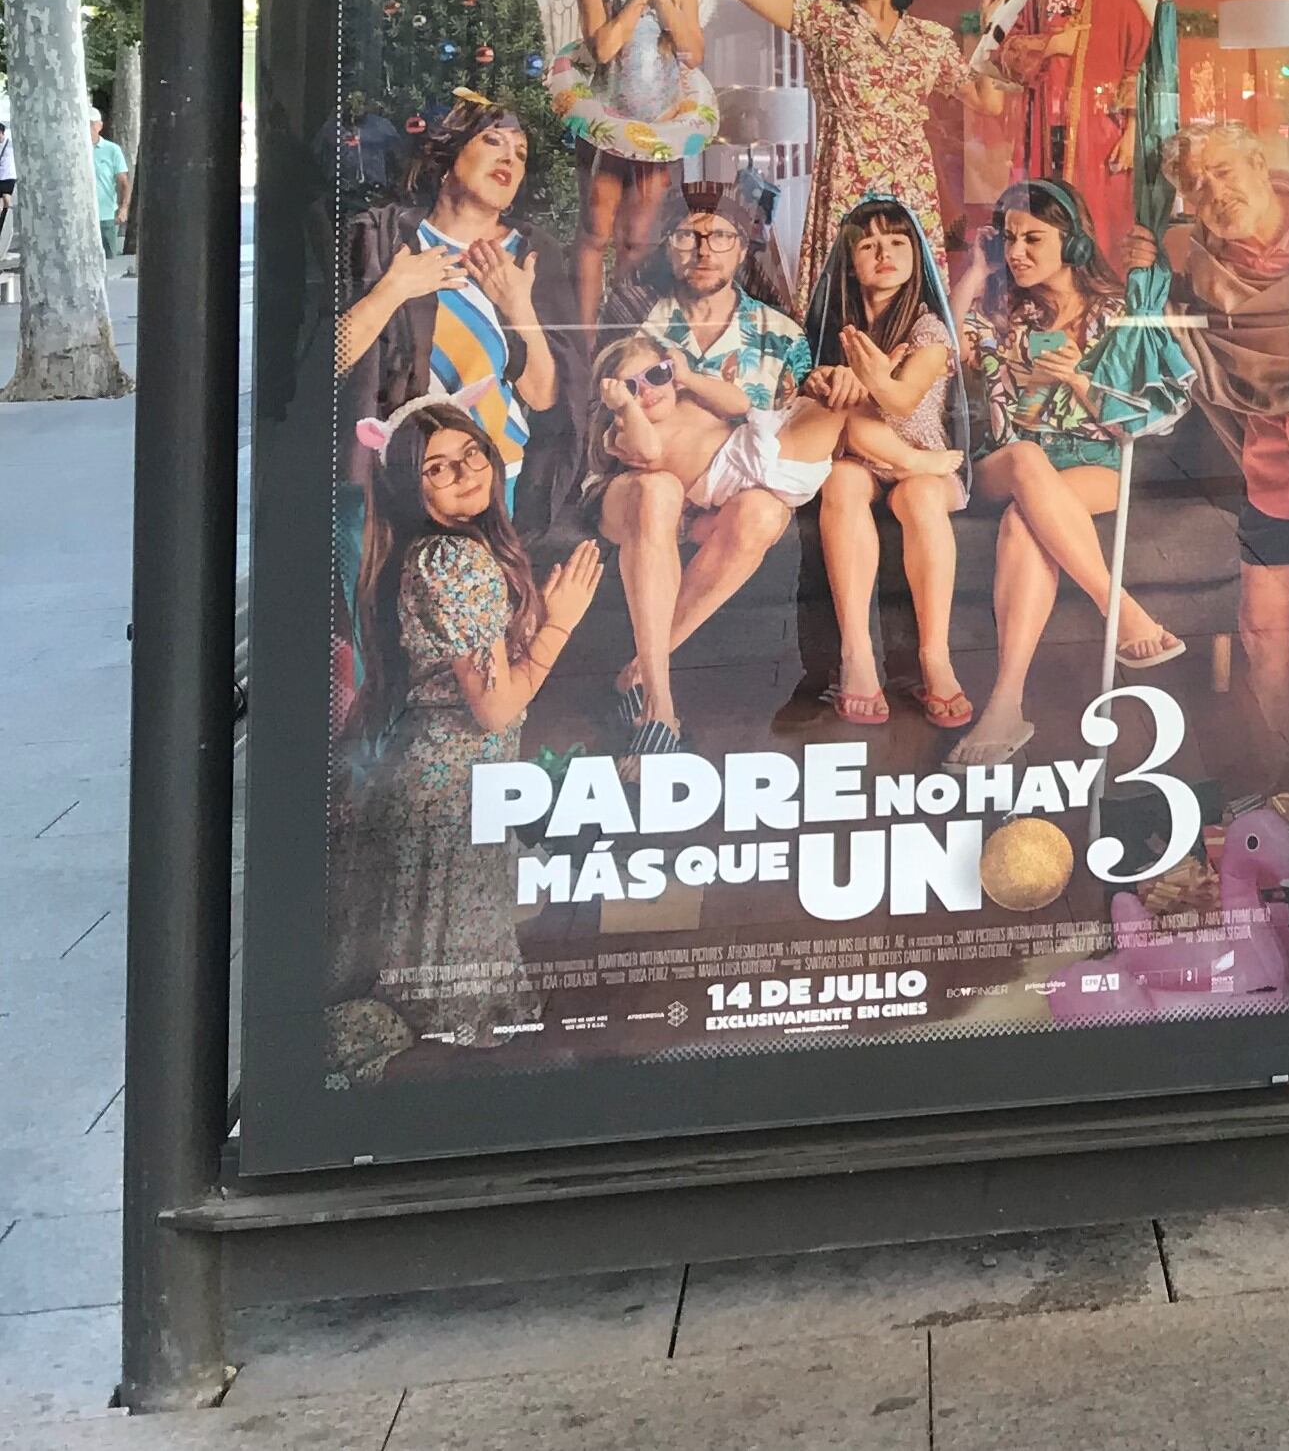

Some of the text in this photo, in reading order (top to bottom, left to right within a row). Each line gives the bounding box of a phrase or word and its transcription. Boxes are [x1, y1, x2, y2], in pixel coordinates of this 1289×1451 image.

[471, 741, 1103, 845] PADRE NO HAY
[1079, 683, 1202, 884] 3
[516, 839, 667, 905] MÁS
[679, 841, 790, 887] QUE
[706, 969, 928, 1011] 14 DE JULIO
[946, 984, 1009, 998] BOWFINGER
[492, 1022, 545, 1034] MOGAMBO
[705, 1001, 928, 1031] EXCLUSIVAMENTE EN CINES
